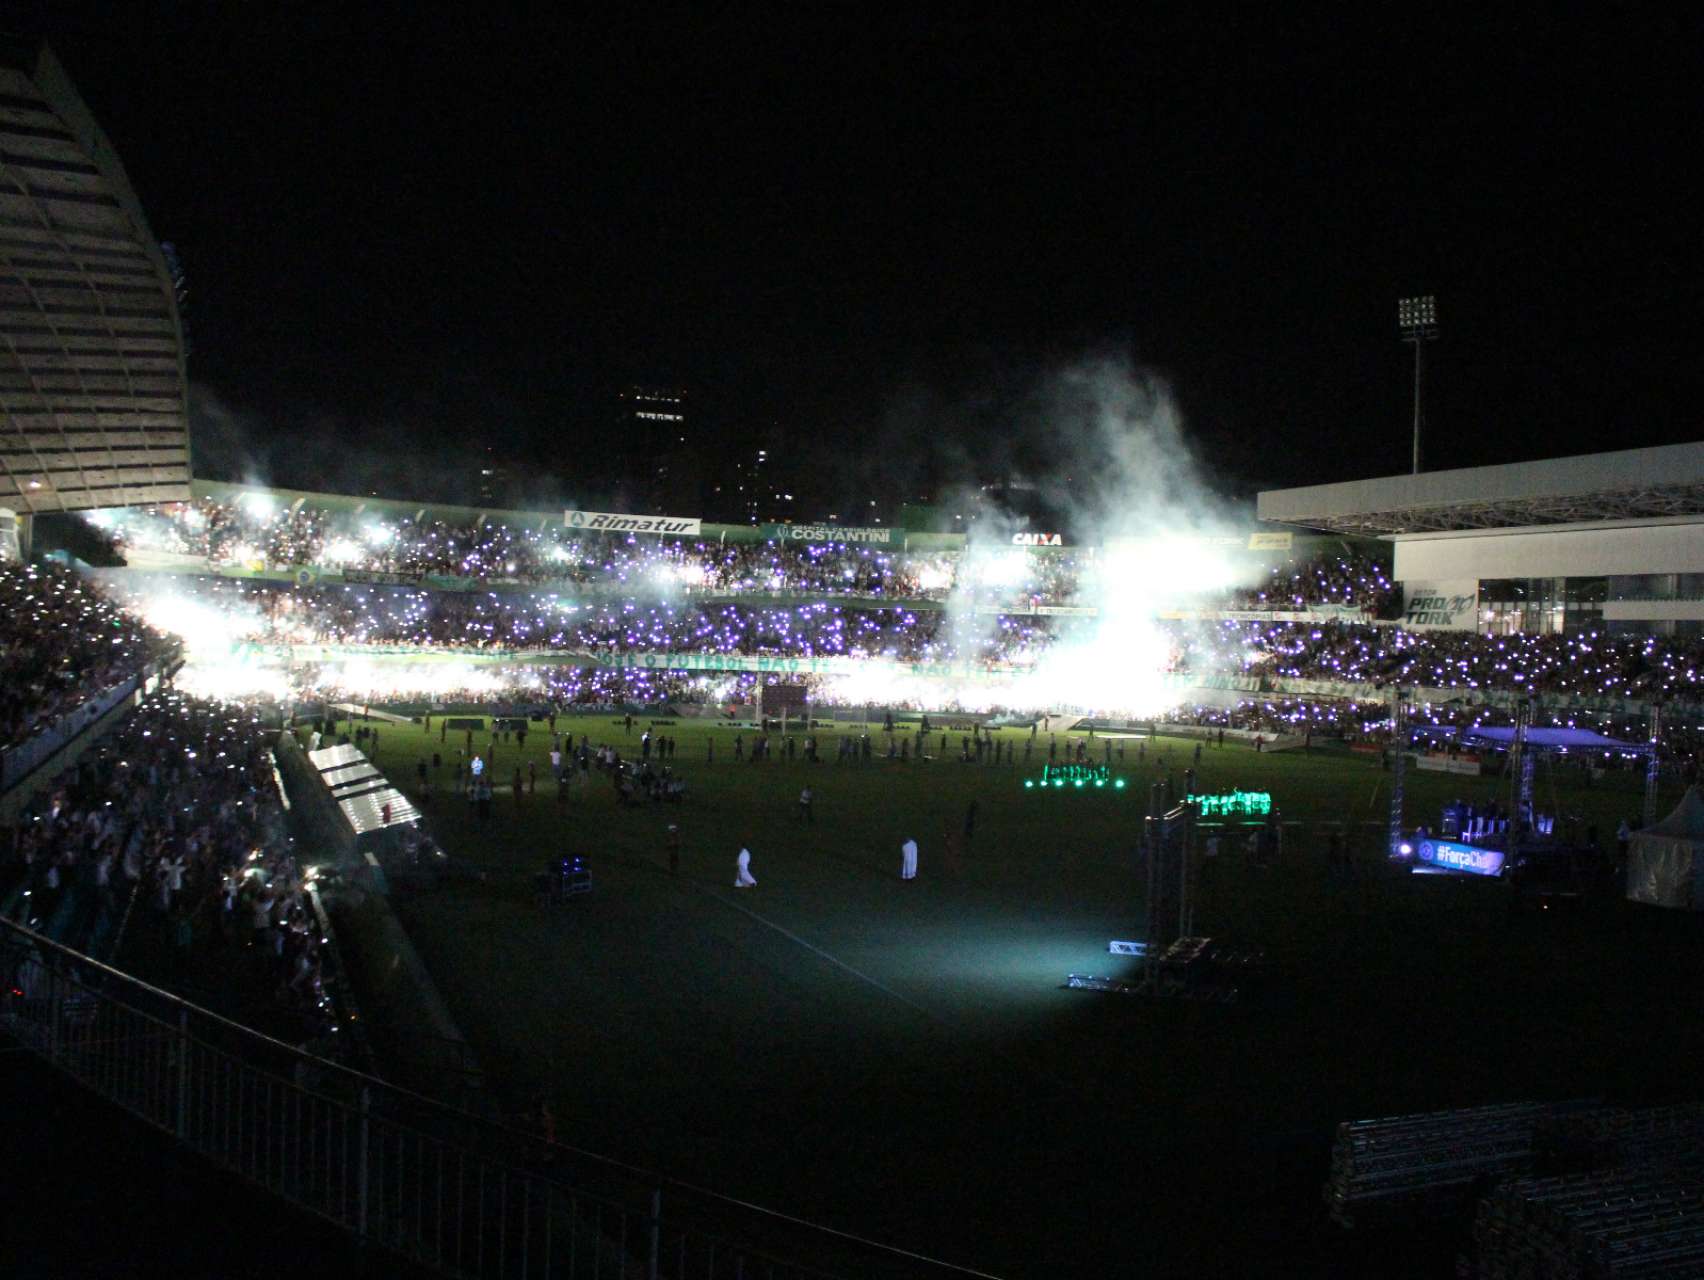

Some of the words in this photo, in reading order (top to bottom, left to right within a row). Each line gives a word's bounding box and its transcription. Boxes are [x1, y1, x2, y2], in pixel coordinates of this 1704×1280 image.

[589, 514, 693, 532] Rimatur
[791, 529, 890, 543] COSTANTINI
[1012, 533, 1062, 545] CAIXA
[1409, 597, 1447, 610] PRO
[1407, 611, 1455, 624] TORK
